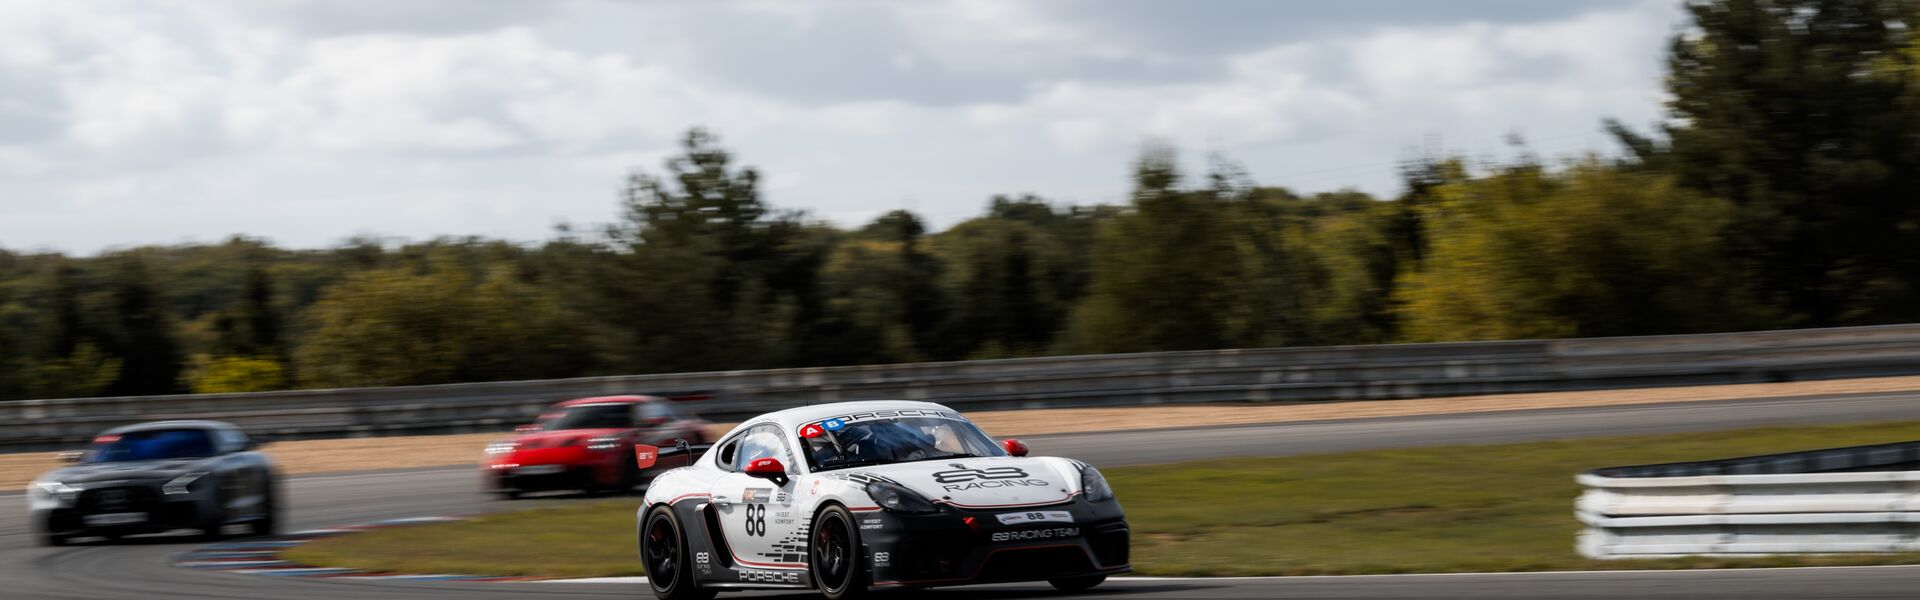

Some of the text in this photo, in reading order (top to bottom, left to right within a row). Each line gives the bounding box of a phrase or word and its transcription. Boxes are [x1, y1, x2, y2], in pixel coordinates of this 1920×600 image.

[830, 410, 960, 421] RSCHE
[826, 420, 840, 428] B
[806, 427, 819, 436] A
[943, 479, 1049, 493] RACING
[745, 503, 766, 537] 88
[1026, 512, 1046, 520] 88
[1010, 529, 1052, 540] RACING
[1053, 527, 1080, 537] TEAM
[739, 570, 799, 583] PORSCHE
